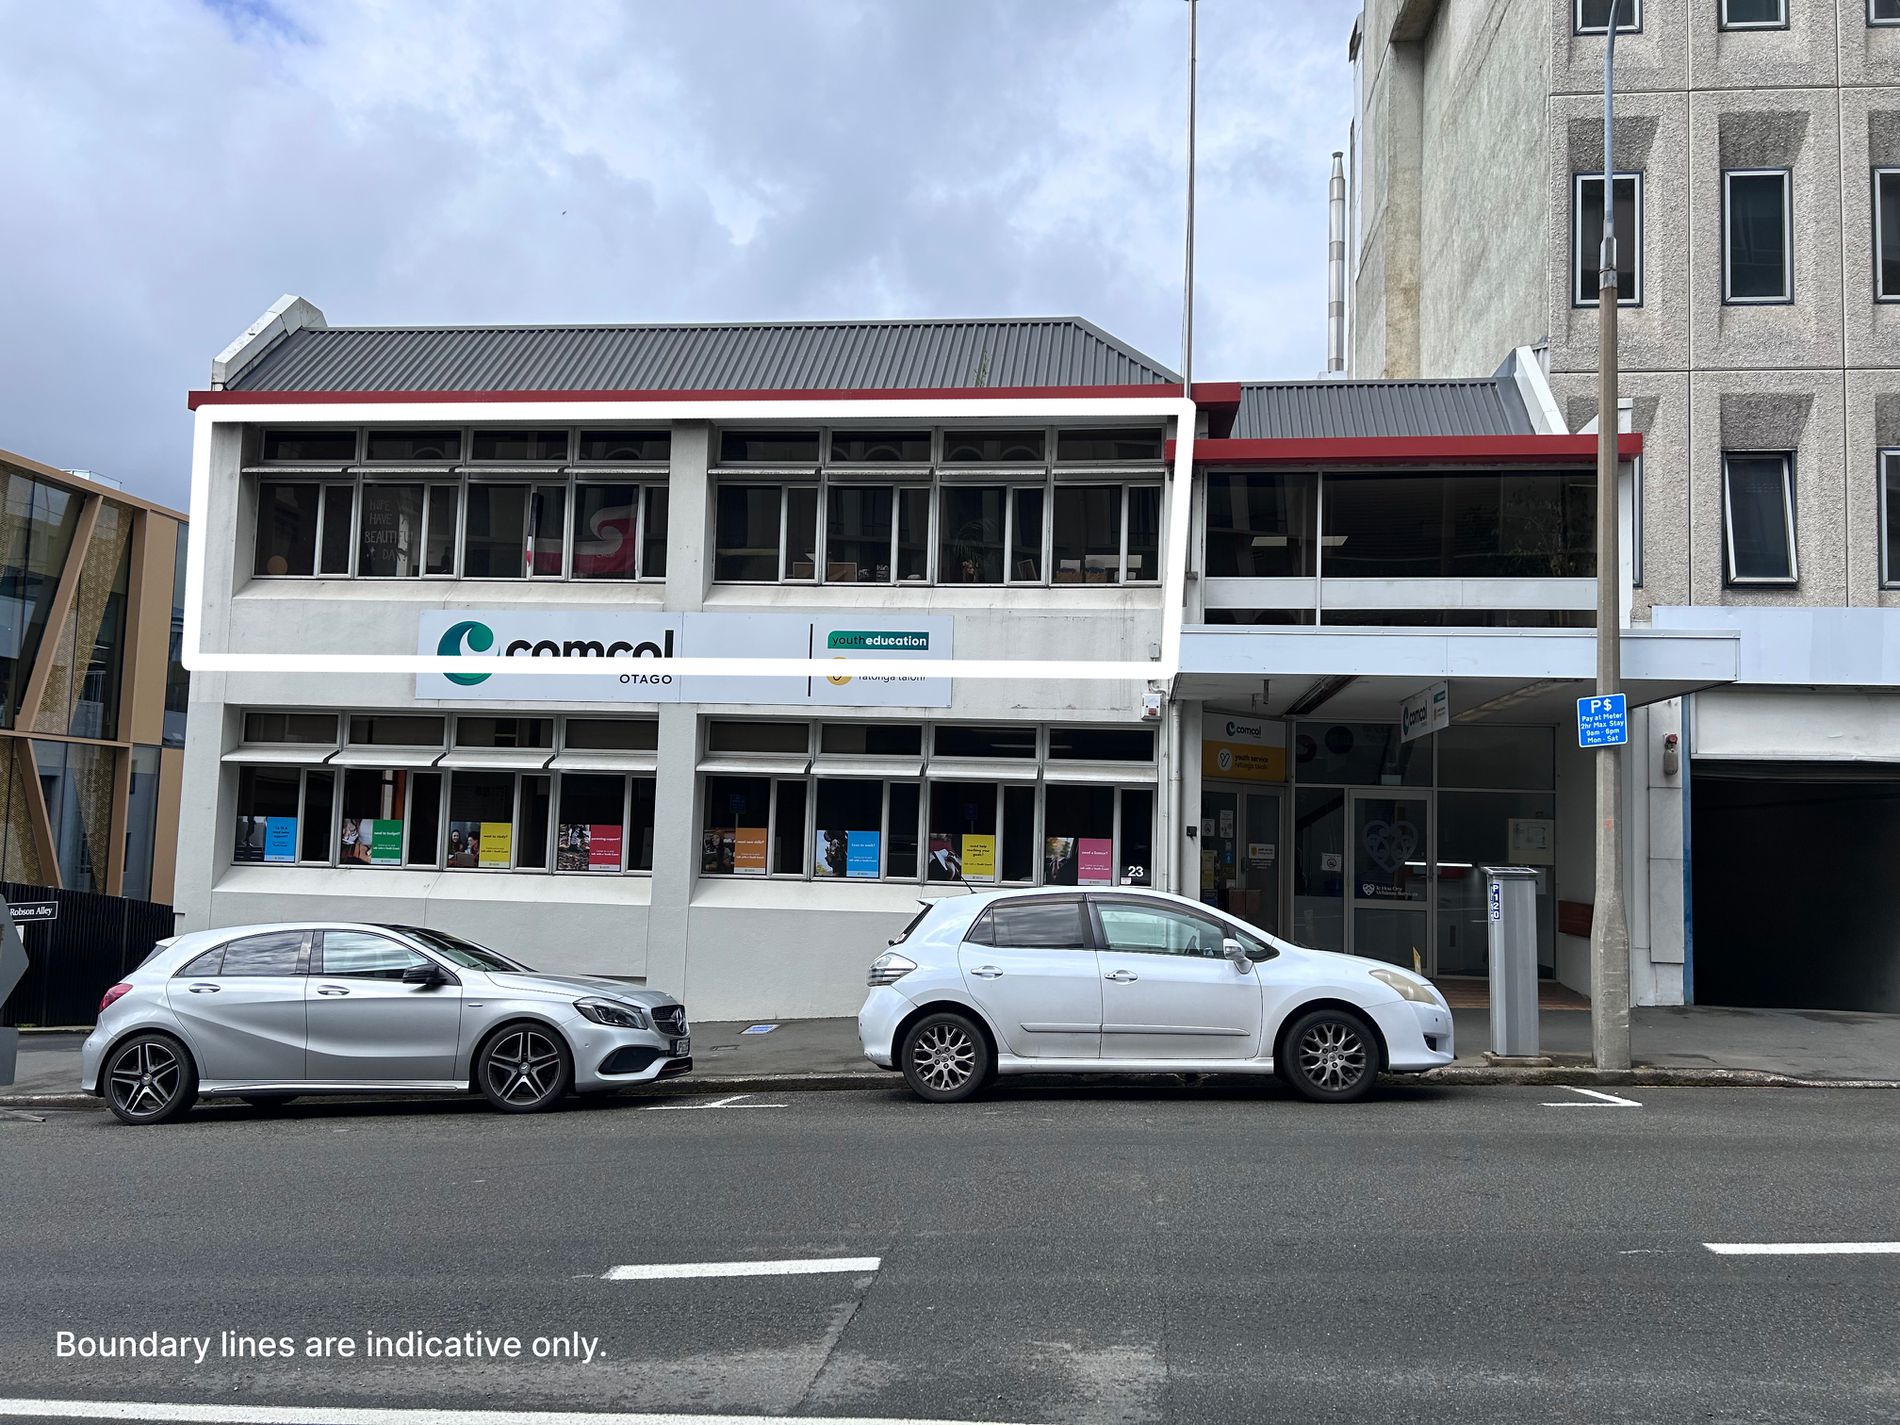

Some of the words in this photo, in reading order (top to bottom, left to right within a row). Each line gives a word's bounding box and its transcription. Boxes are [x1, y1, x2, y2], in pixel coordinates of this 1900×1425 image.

[619, 674, 673, 685] OTAGO
[1603, 712, 1622, 720] Meter
[1236, 724, 1262, 737] comcol
[1607, 734, 1619, 742] Sat
[1128, 865, 1144, 877] 23
[10, 907, 34, 916] Robson
[36, 906, 52, 916] Alley
